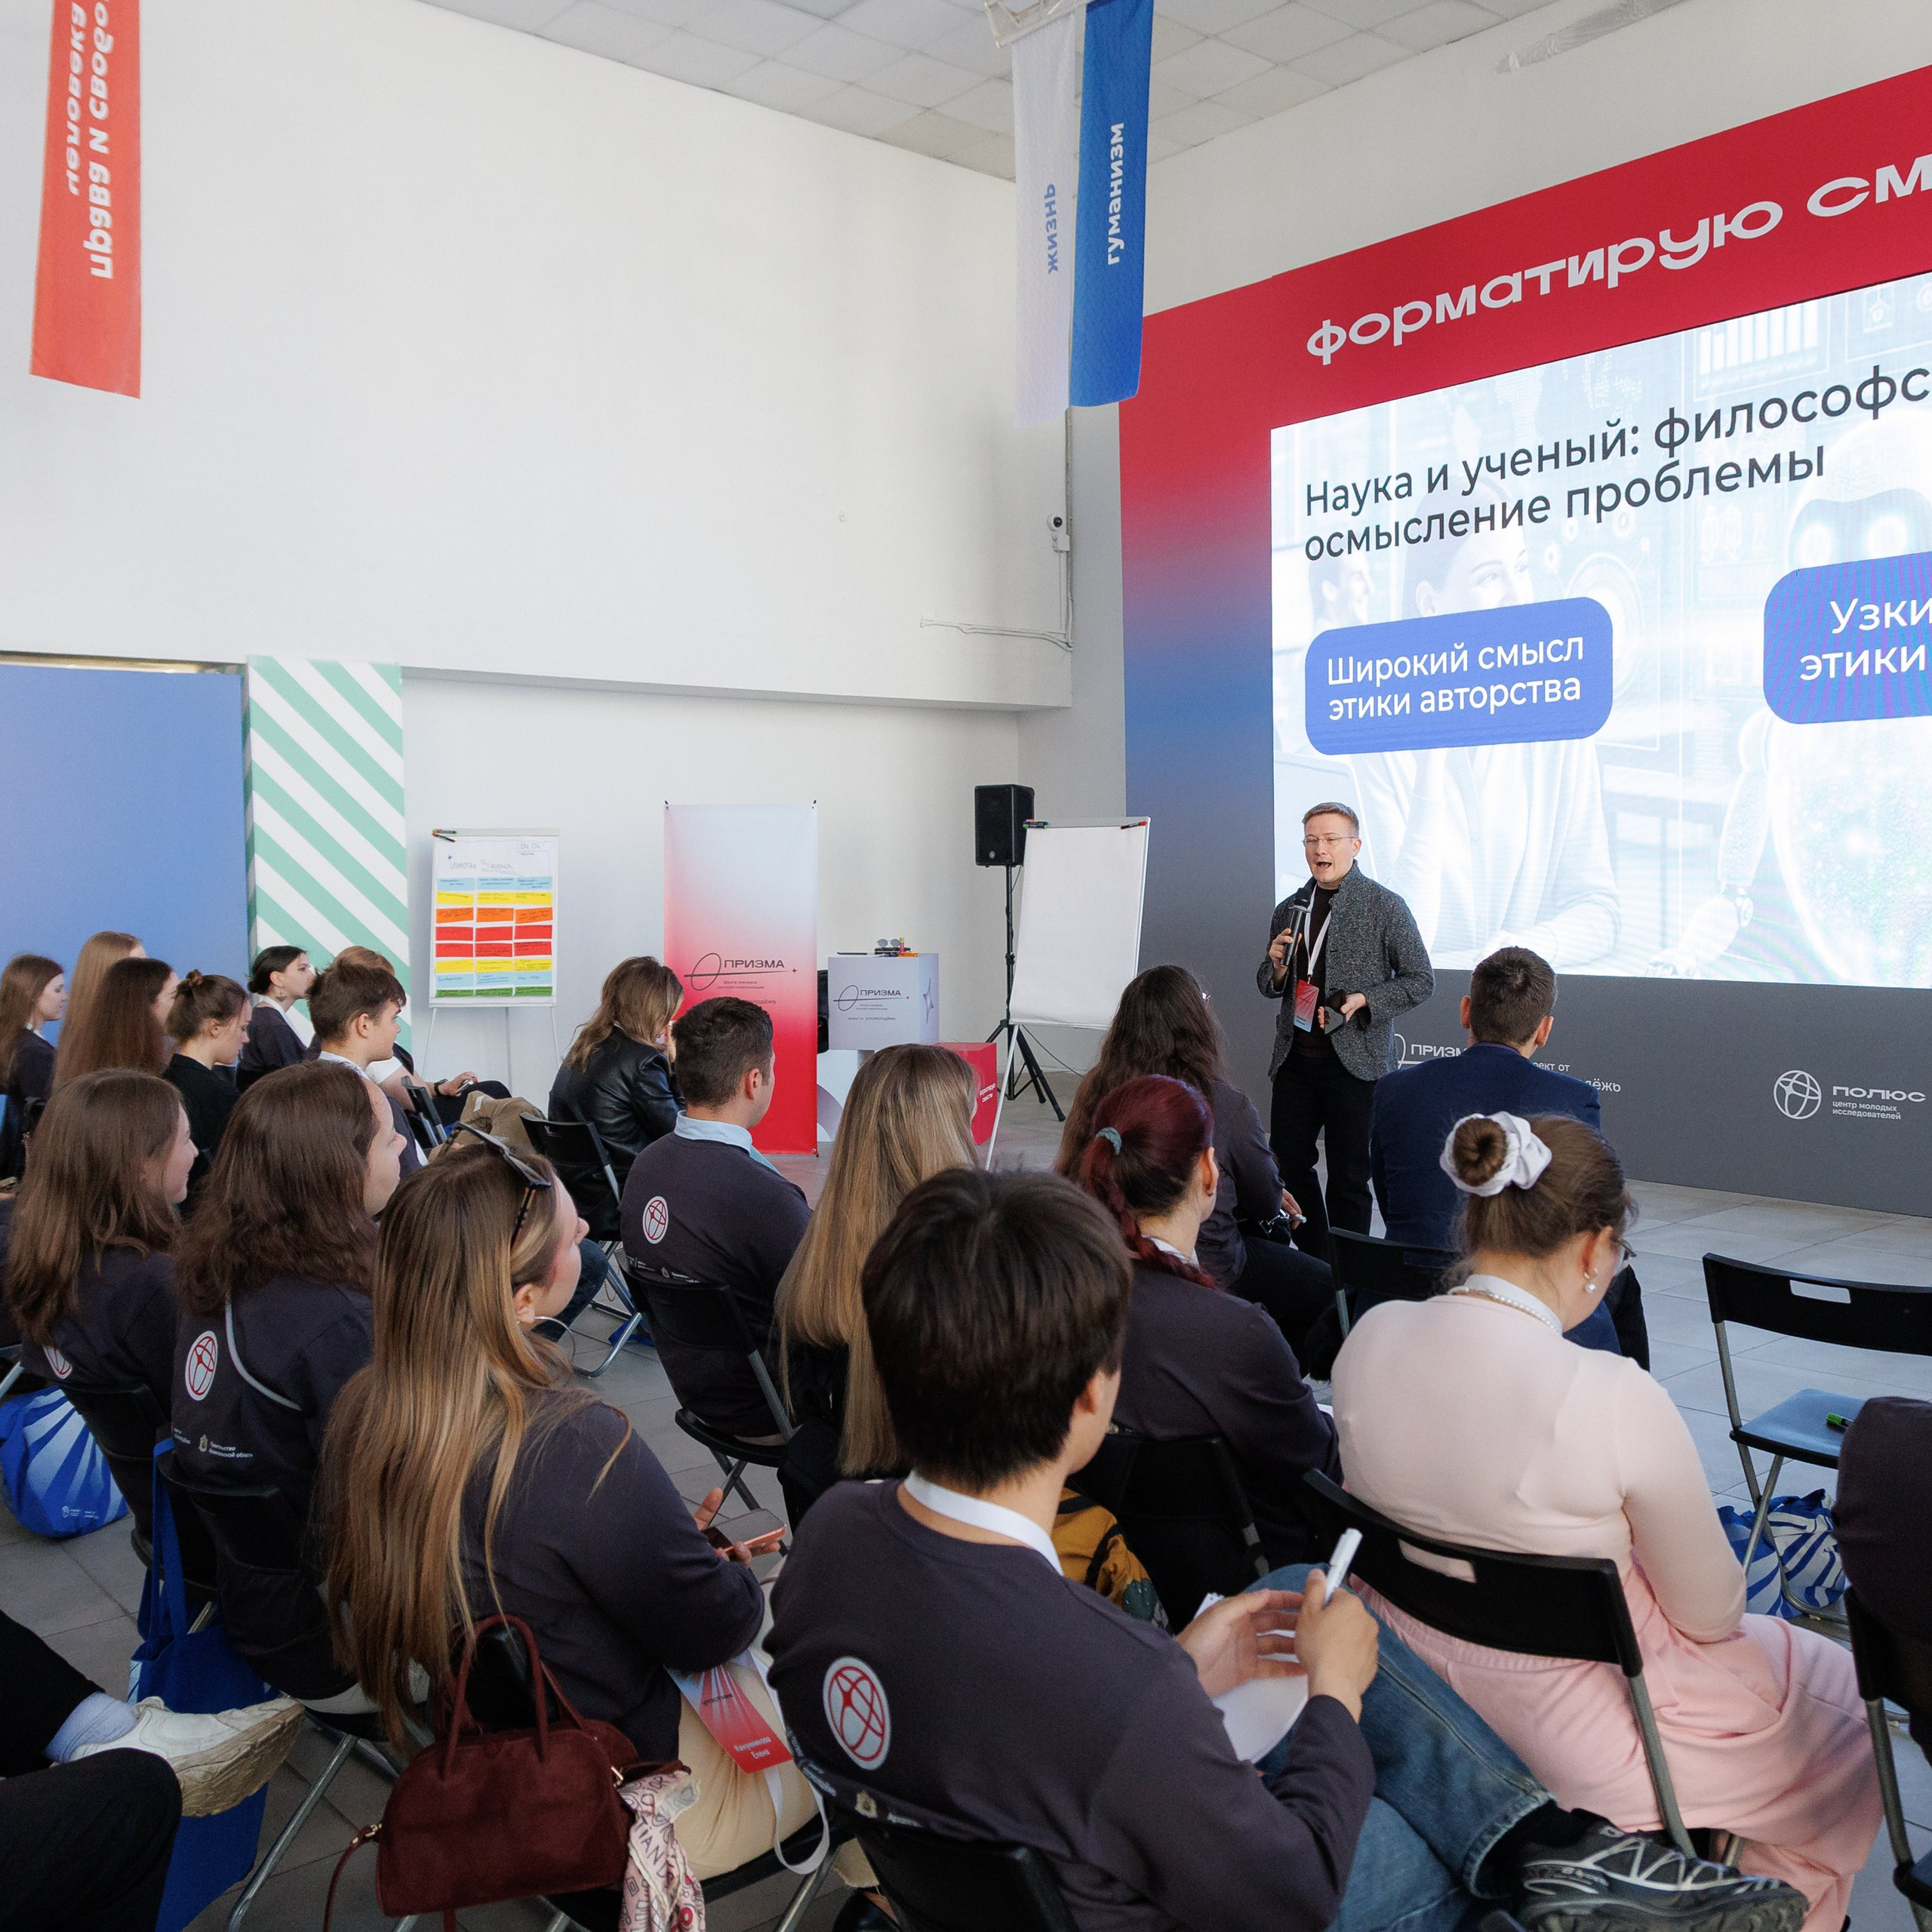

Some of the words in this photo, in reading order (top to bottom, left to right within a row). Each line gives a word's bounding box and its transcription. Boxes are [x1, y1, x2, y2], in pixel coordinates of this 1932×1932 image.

[1107, 122, 1124, 266] гуманизм
[1044, 183, 1059, 275] жизнь
[1306, 200, 1783, 365] форматирую
[1306, 472, 1413, 517] Наука
[1427, 463, 1448, 494] и
[1461, 417, 1639, 497] ученый:
[1654, 365, 1930, 458] философс
[1305, 495, 1551, 561] осмысление
[1567, 445, 1823, 523] проблемы
[1327, 641, 1468, 688] Широкий
[1478, 636, 1584, 670] смысл
[1800, 645, 1925, 681] этики
[1328, 692, 1411, 721] этики
[1420, 676, 1581, 715] авторства
[724, 959, 785, 968] ПРИЗМА
[1558, 1063, 1571, 1072] от
[1832, 1108, 1901, 1120] исследователей
[1859, 1103, 1897, 1112] молодых
